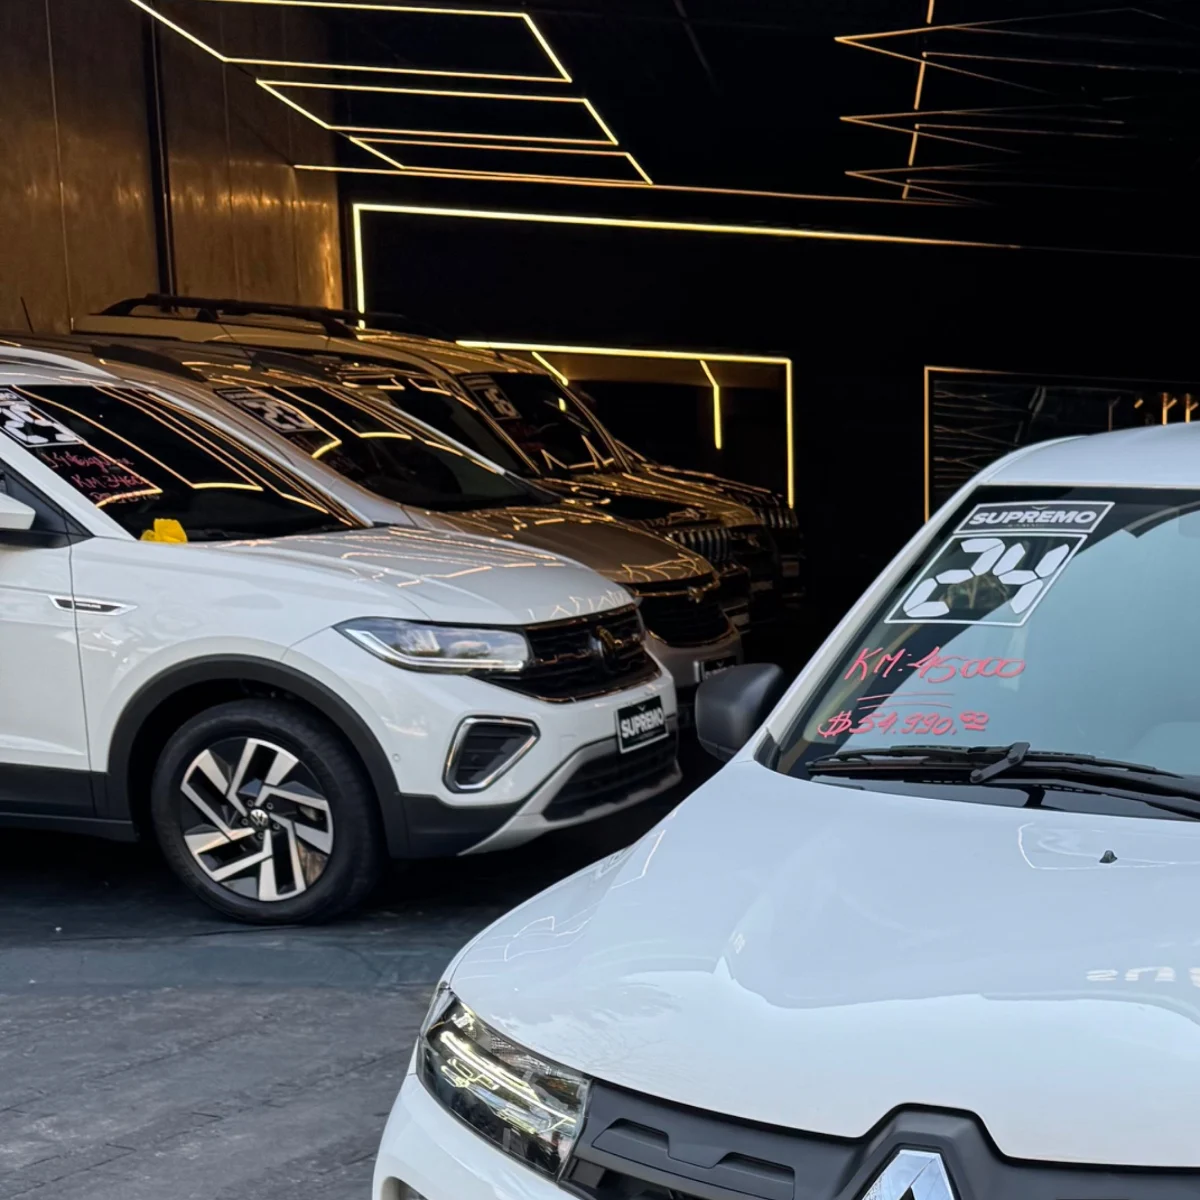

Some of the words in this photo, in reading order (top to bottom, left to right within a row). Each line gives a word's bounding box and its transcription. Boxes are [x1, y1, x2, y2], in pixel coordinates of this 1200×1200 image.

[968, 510, 1097, 525] SUPREMO
[903, 537, 1070, 618] 24
[620, 707, 664, 739] SUPREMO
